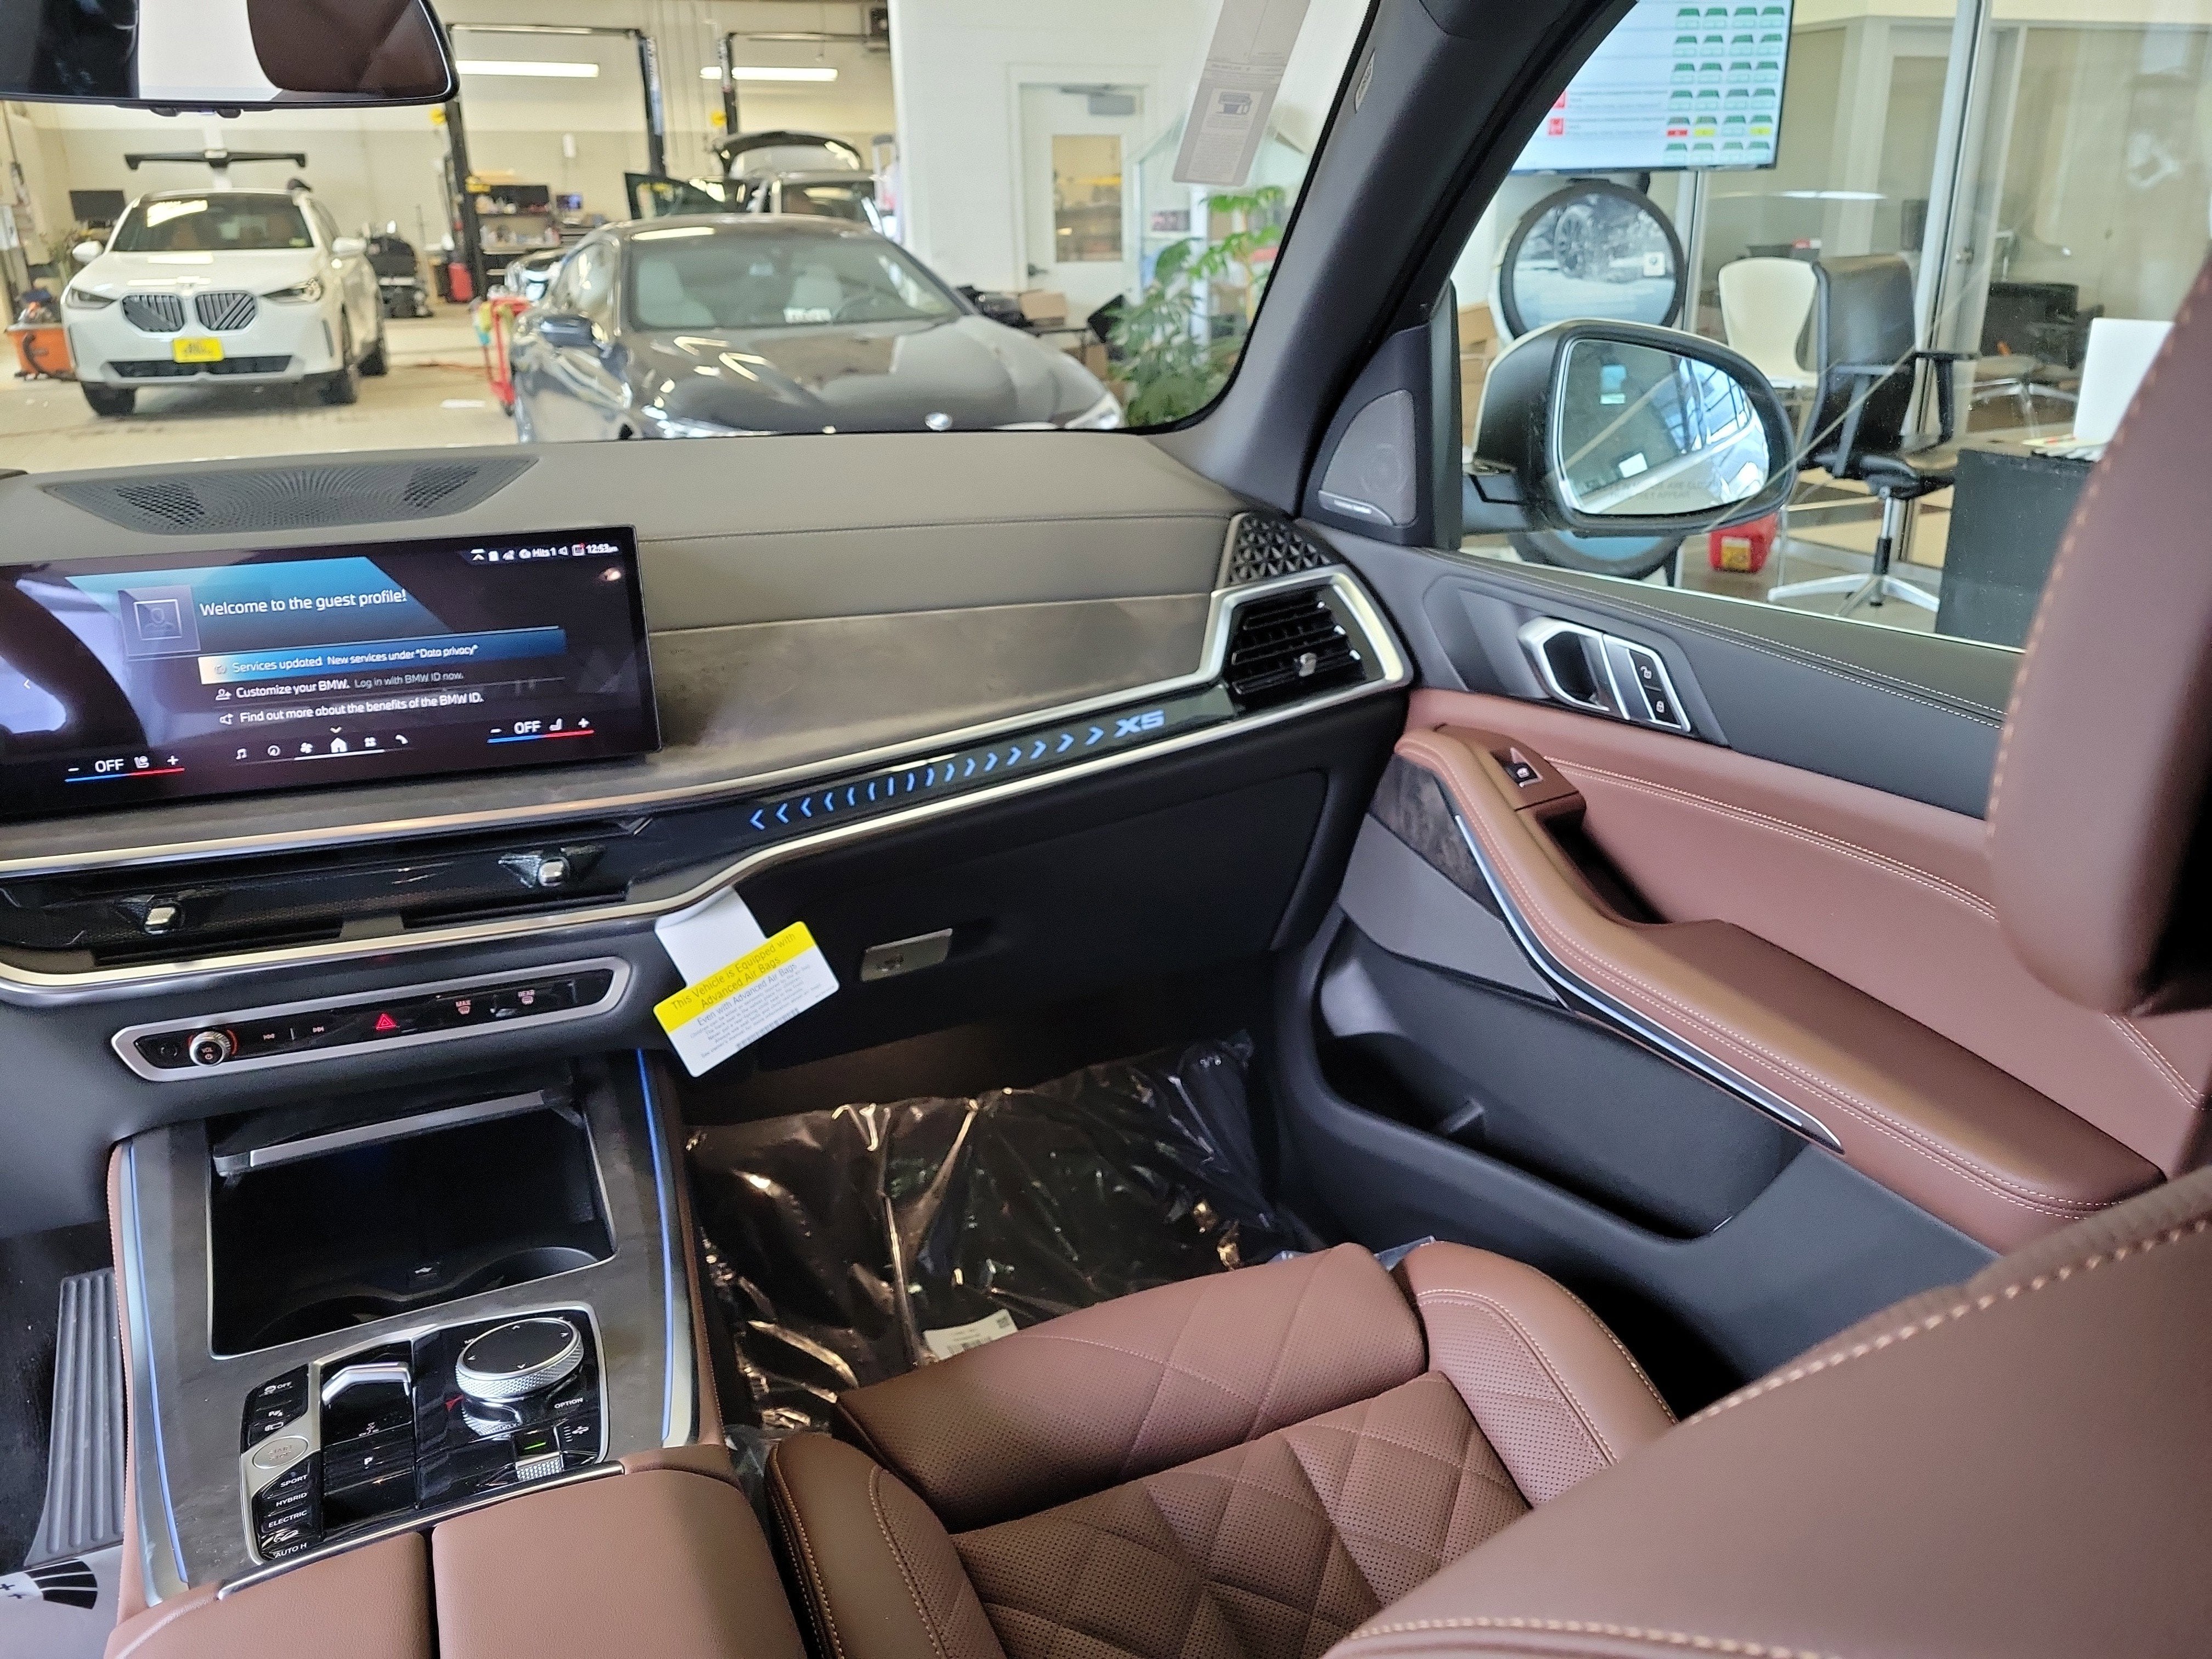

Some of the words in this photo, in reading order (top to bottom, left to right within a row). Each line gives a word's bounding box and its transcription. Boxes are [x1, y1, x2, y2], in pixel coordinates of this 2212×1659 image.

[199, 601, 268, 616] Welcome
[270, 599, 285, 612] to
[289, 596, 313, 610] the
[315, 594, 357, 611] guest
[359, 588, 408, 608] profile!
[232, 661, 277, 673] Services
[279, 656, 323, 670] updated
[327, 656, 348, 665] New
[350, 653, 387, 664] services
[388, 650, 415, 661] under
[235, 685, 292, 698] Customize
[292, 683, 318, 696] your
[318, 679, 351, 692] BMW.
[354, 679, 372, 689] Log
[374, 678, 382, 686] in
[384, 676, 403, 686] with
[404, 673, 429, 684] BMW
[431, 672, 441, 681] ID
[240, 711, 264, 724] Find
[266, 711, 285, 720] out
[285, 708, 314, 719] more
[315, 704, 347, 717] about
[347, 702, 364, 713] the
[366, 699, 407, 713] benefits
[408, 697, 420, 708] of
[420, 696, 438, 707] the
[439, 693, 467, 706] BMW
[468, 692, 484, 703] ID.
[514, 720, 541, 735] OFF
[1113, 709, 1165, 738] X5
[94, 758, 124, 773] OFF
[670, 995, 692, 1009] This
[691, 976, 725, 997] Vehicle
[726, 970, 735, 978] is
[735, 944, 776, 973] Equipped
[776, 933, 796, 949] with
[701, 978, 743, 1009] Advanced
[744, 970, 757, 983] Air
[758, 958, 781, 974] Bags
[697, 1012, 716, 1026] Even
[716, 1002, 732, 1014] with
[733, 980, 767, 1005] Advanced
[768, 974, 777, 983] Air
[778, 963, 798, 977] Bags
[276, 1381, 292, 1389] OFF
[554, 1397, 584, 1409] OPTION
[364, 1456, 373, 1465] P
[280, 1474, 308, 1488] SPORT
[275, 1492, 308, 1507] HYBRID
[268, 1510, 308, 1528] ELECTRIC
[274, 1544, 299, 1559] AUTO
